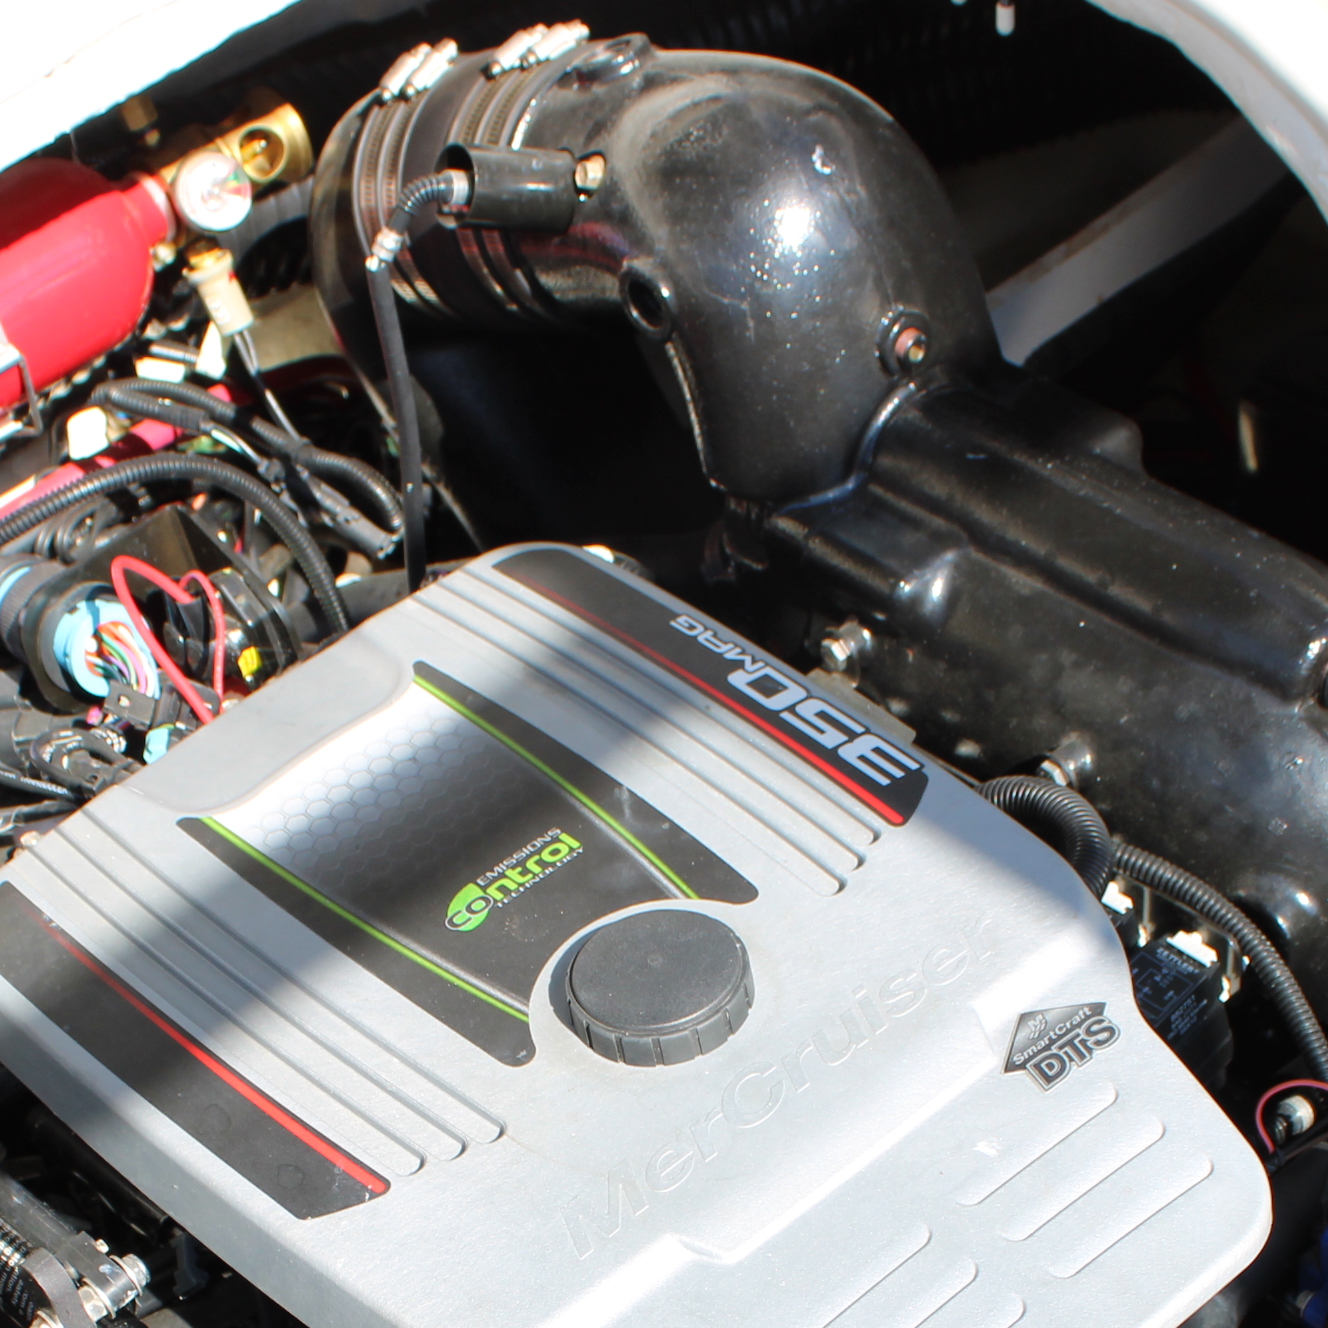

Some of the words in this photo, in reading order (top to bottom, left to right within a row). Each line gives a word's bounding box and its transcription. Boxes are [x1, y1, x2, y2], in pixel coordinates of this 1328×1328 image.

[670, 614, 765, 673] MAG
[727, 666, 921, 787] 350
[476, 826, 562, 887] EMISSIONS
[495, 846, 584, 908] TECHNOLOGY
[1012, 1006, 1092, 1066] SmartCraft
[1025, 1015, 1121, 1092] DTS
[561, 915, 992, 1261] MerCruiser
